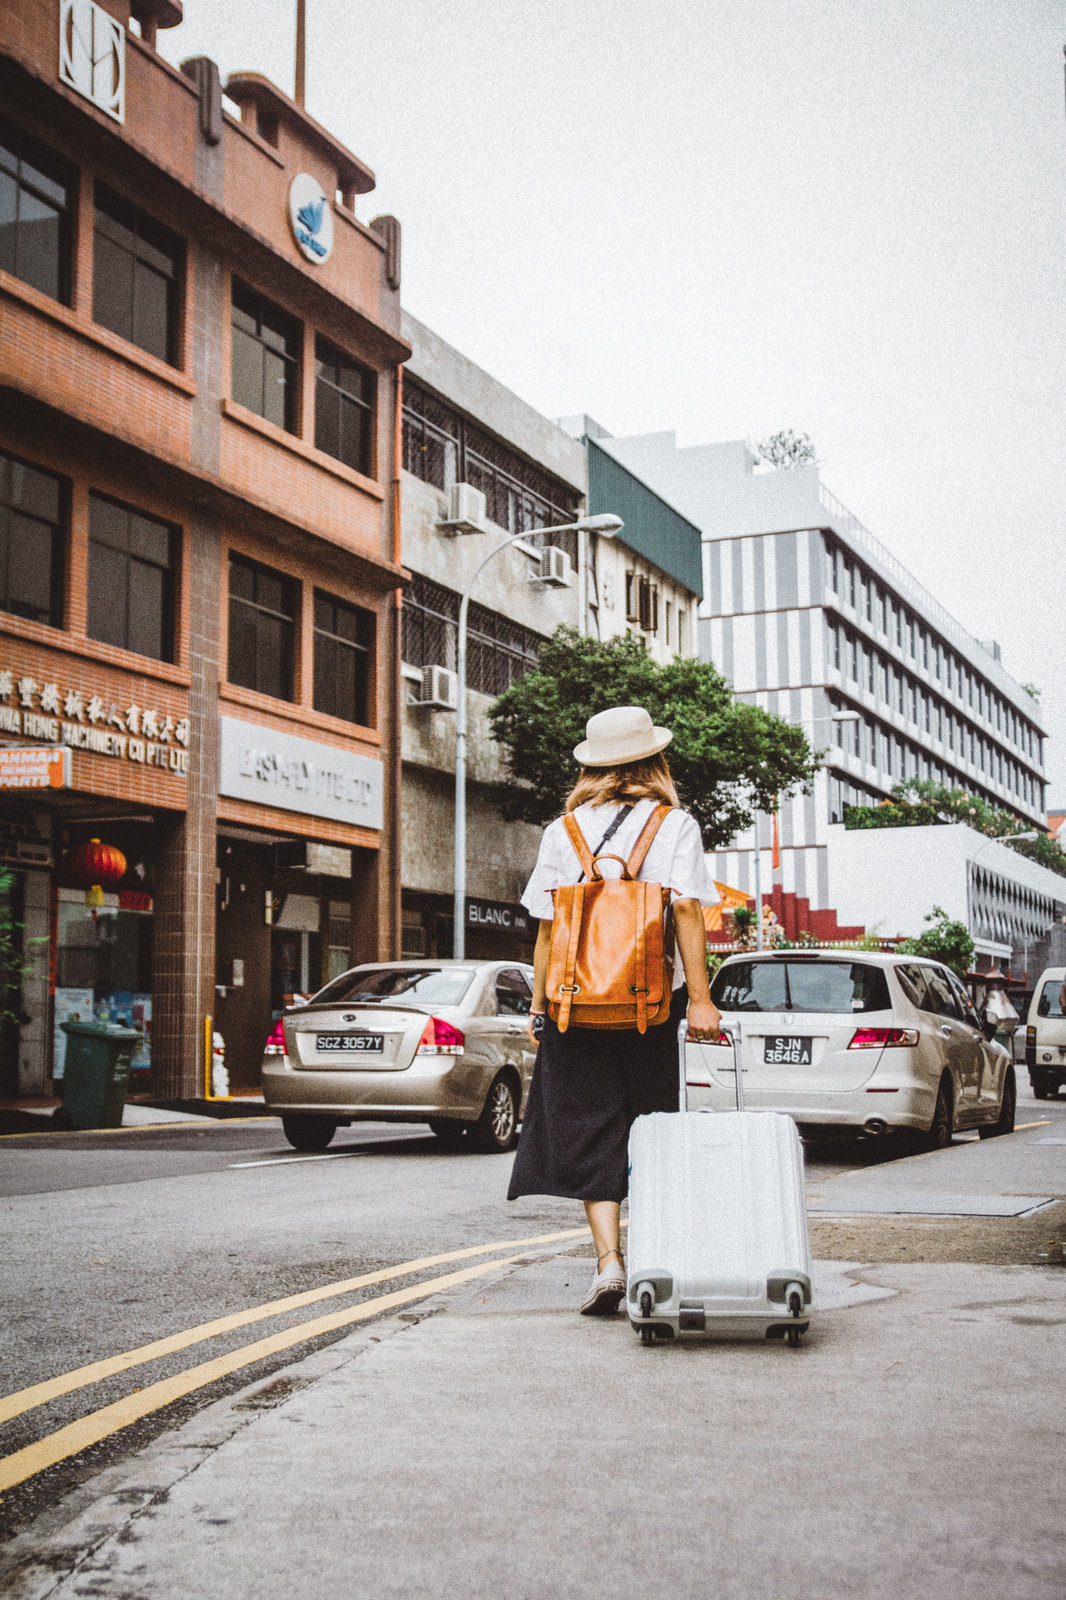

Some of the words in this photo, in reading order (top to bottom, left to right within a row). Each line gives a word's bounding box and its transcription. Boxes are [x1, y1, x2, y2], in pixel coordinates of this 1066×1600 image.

[0, 704, 20, 734] WA
[23, 711, 60, 741] HONG
[61, 721, 127, 758] MACHINERY
[128, 739, 145, 763] CO
[146, 742, 168, 768] PTE
[469, 904, 511, 927] BLANC
[317, 1036, 341, 1049] SGZ
[341, 1036, 382, 1049] 3057Y
[775, 1038, 801, 1050] SJN
[765, 1049, 810, 1063] 3646A
